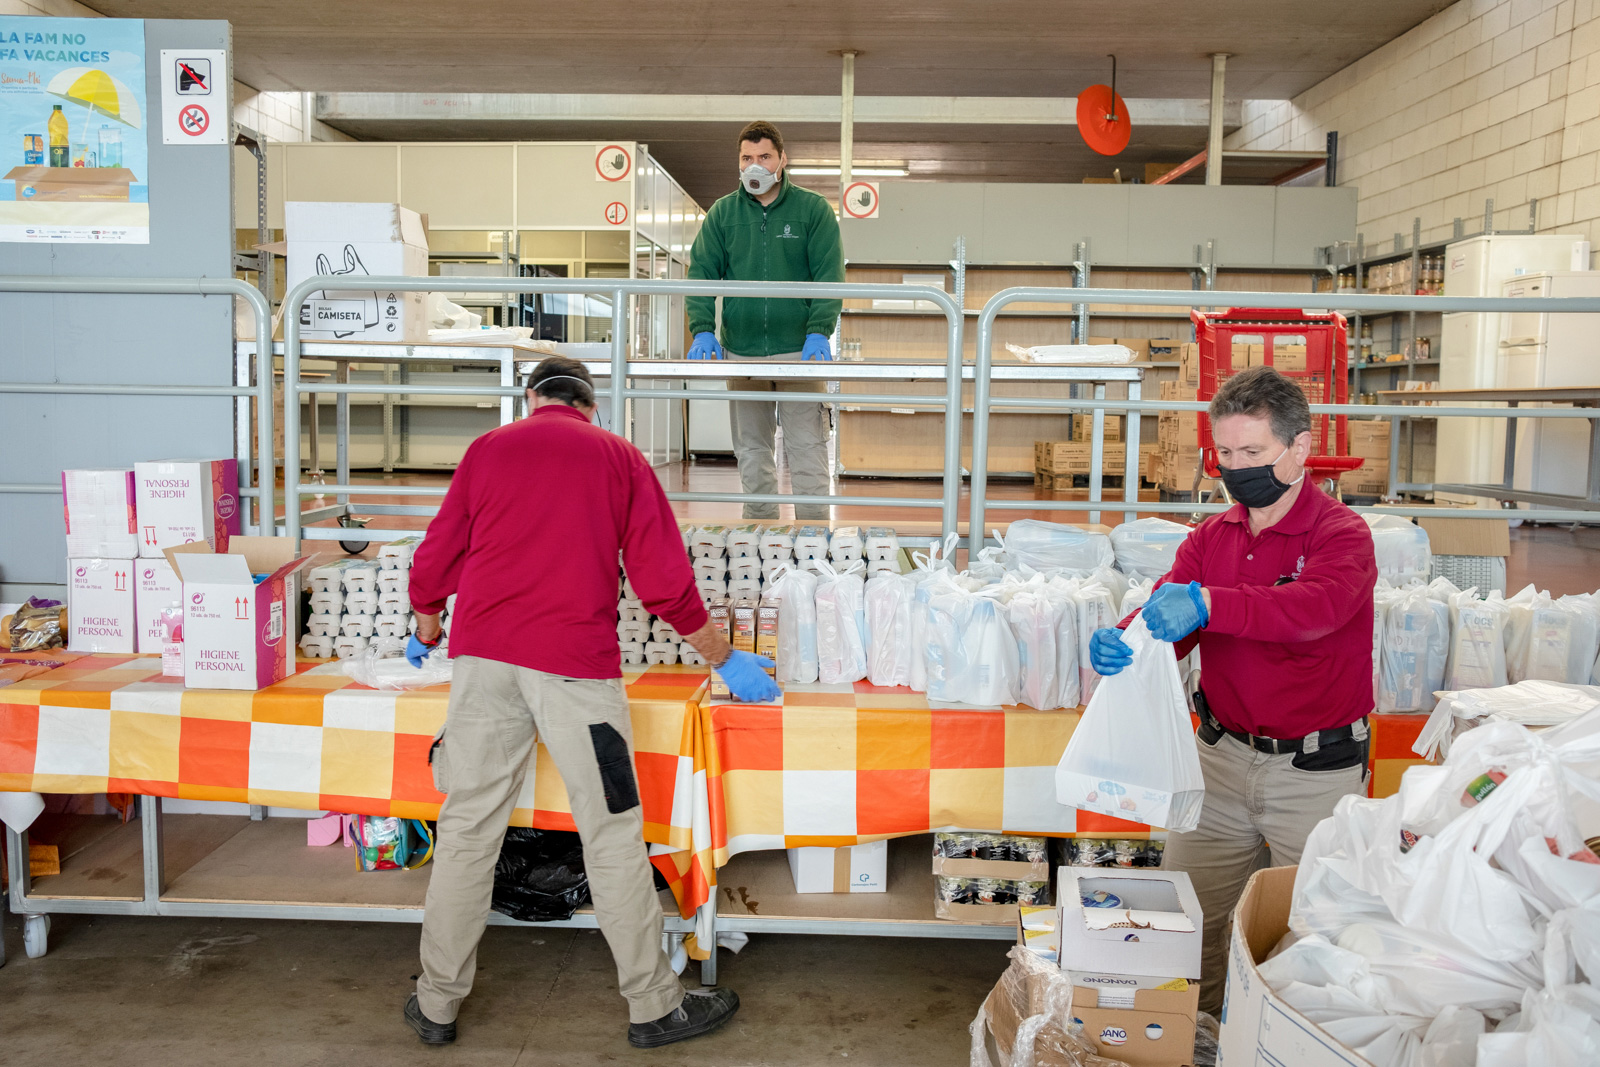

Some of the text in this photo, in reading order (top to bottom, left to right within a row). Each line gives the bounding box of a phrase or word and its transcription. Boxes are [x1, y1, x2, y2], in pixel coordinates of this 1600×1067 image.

[0, 32, 86, 45] LA FAM NO
[0, 49, 110, 62] FA VACANCES
[318, 311, 362, 320] CAMISETA
[144, 480, 189, 488] PERSONAL
[150, 490, 185, 498] HIGIENE
[83, 617, 119, 627] HIGIENE
[78, 627, 123, 637] PERSONAL
[200, 650, 240, 660] HIGIENE
[195, 661, 246, 672] PERSONAL
[1475, 782, 1497, 801] gullón
